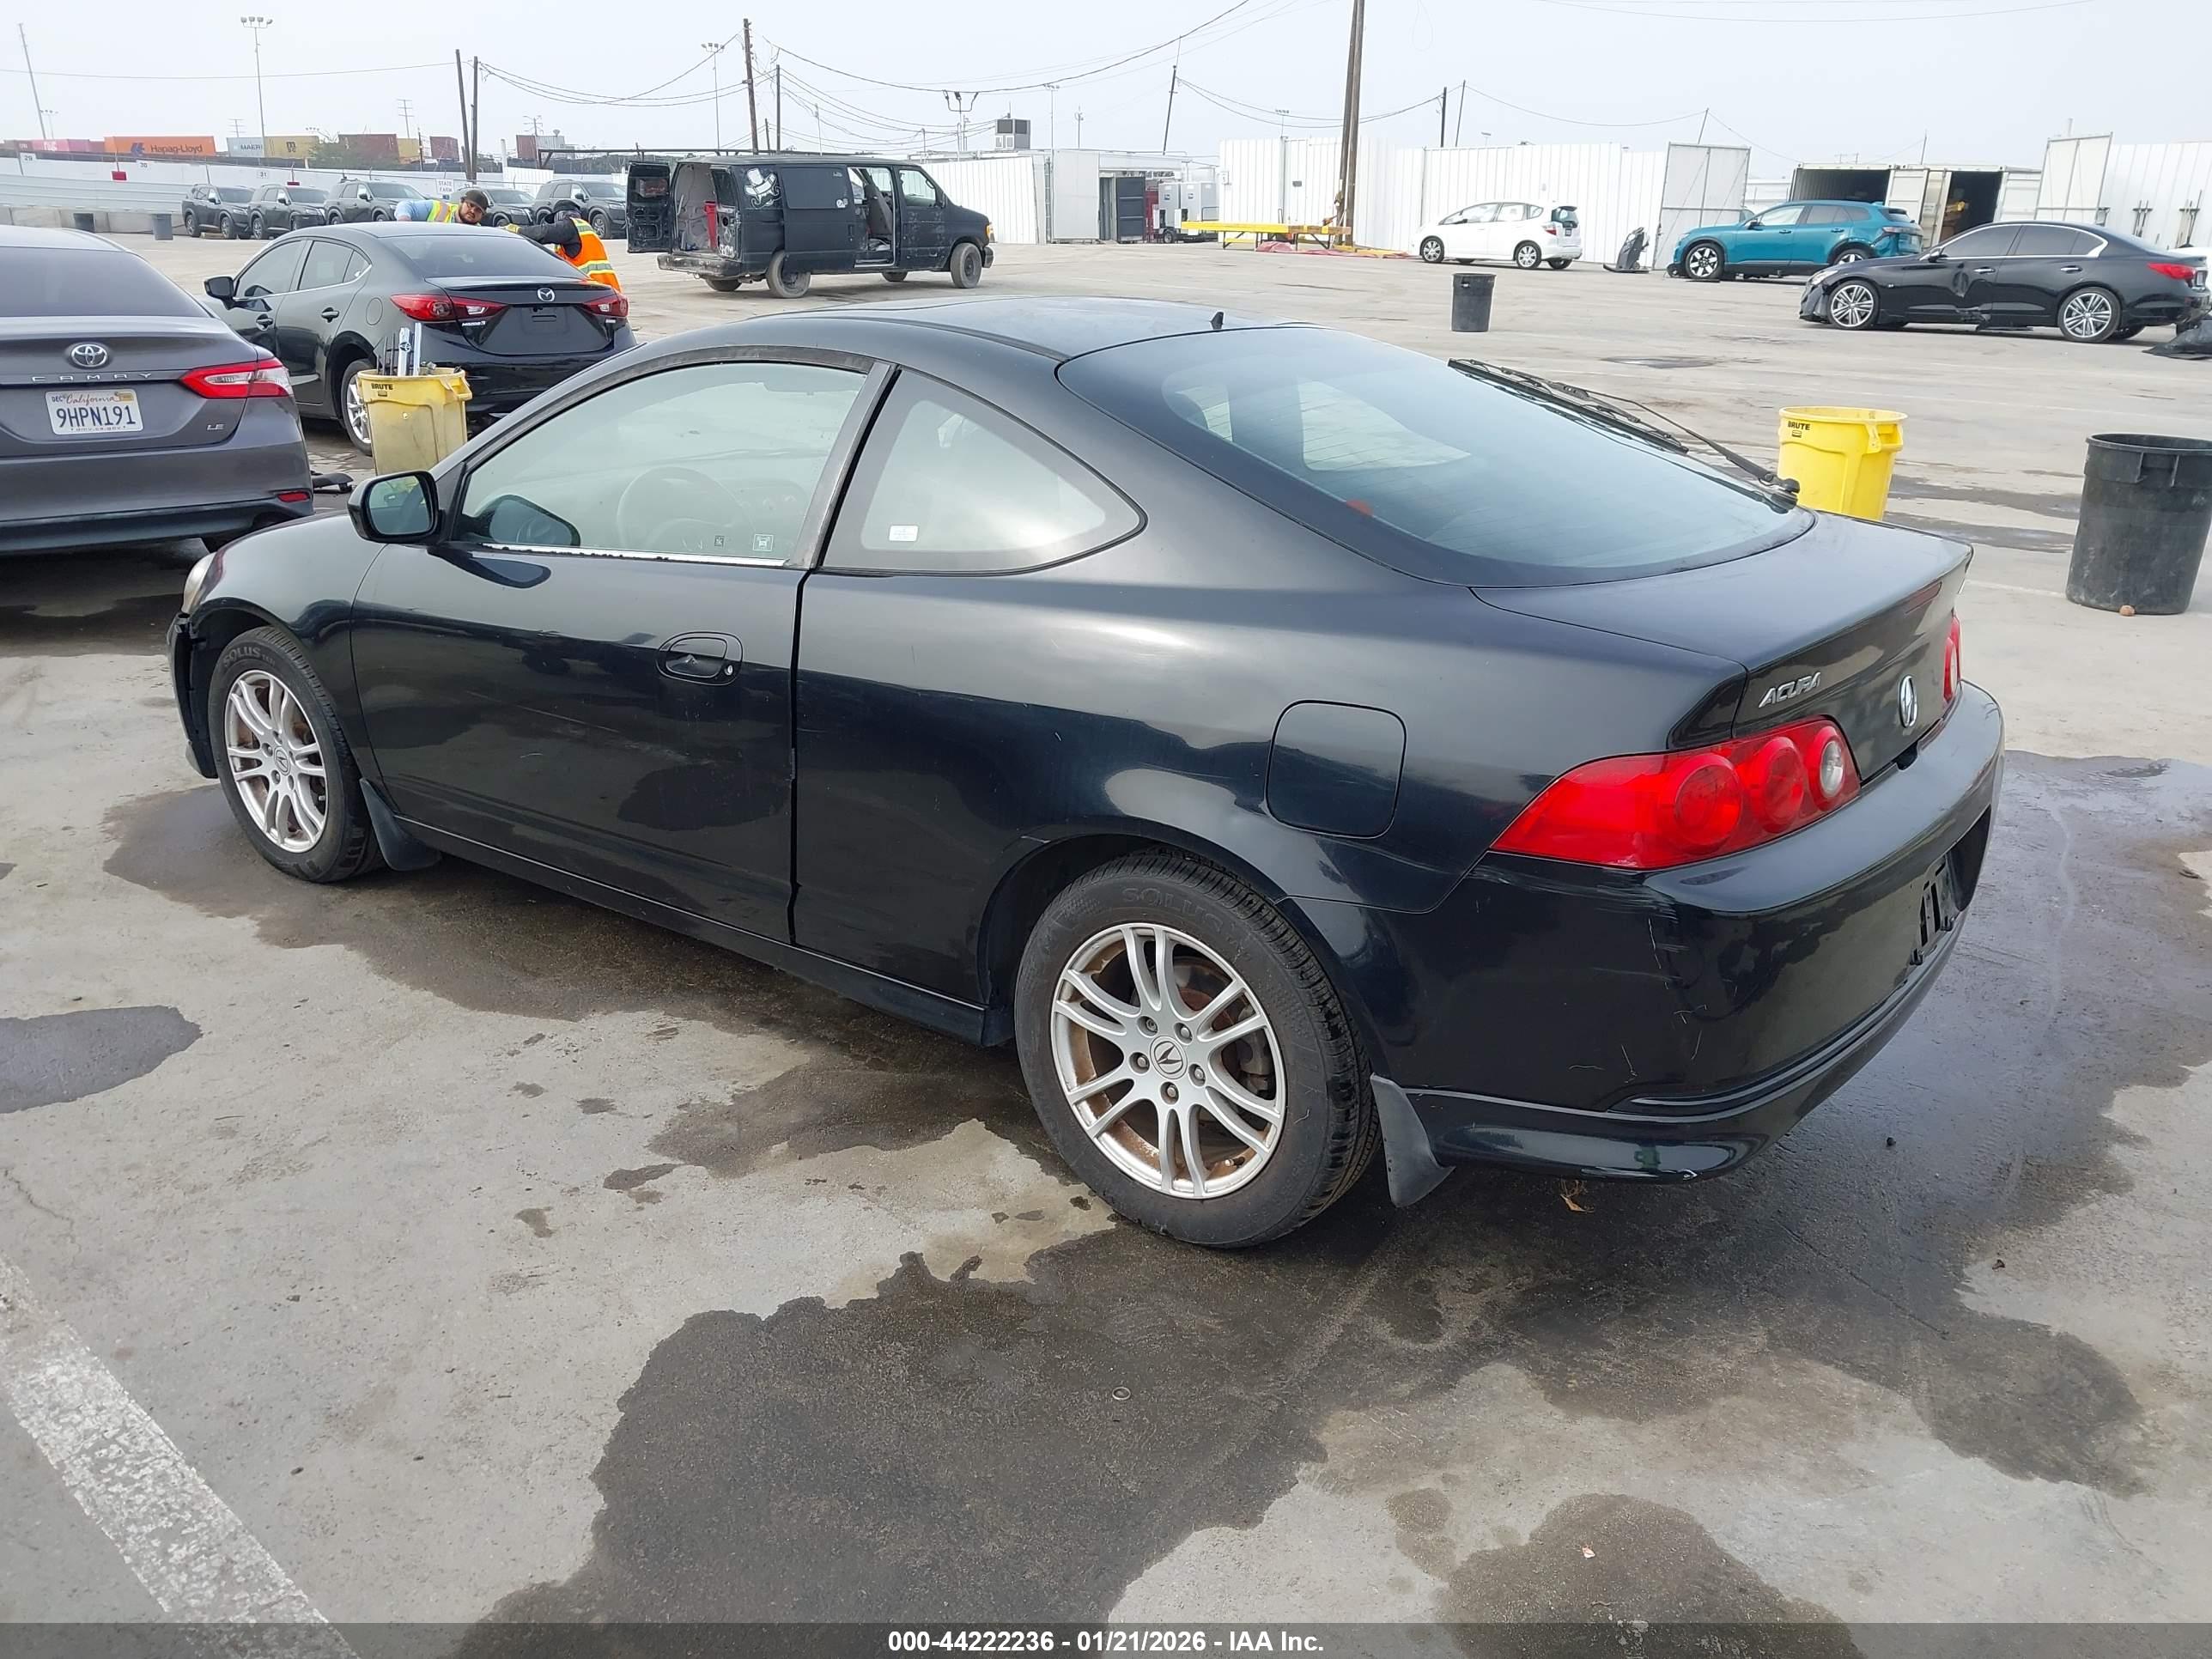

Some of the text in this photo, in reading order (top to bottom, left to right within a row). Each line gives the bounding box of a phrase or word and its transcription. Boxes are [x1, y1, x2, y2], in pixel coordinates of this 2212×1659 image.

[150, 144, 203, 154] Hapag-Lloyd
[32, 373, 152, 382] CAMRY
[65, 394, 115, 406] California
[56, 405, 137, 428] 9HPN191
[1788, 421, 1811, 430] BRUTE
[223, 646, 261, 667] SOLUS
[1759, 672, 1821, 708] ACURA
[1121, 887, 1224, 938] SOLUS
